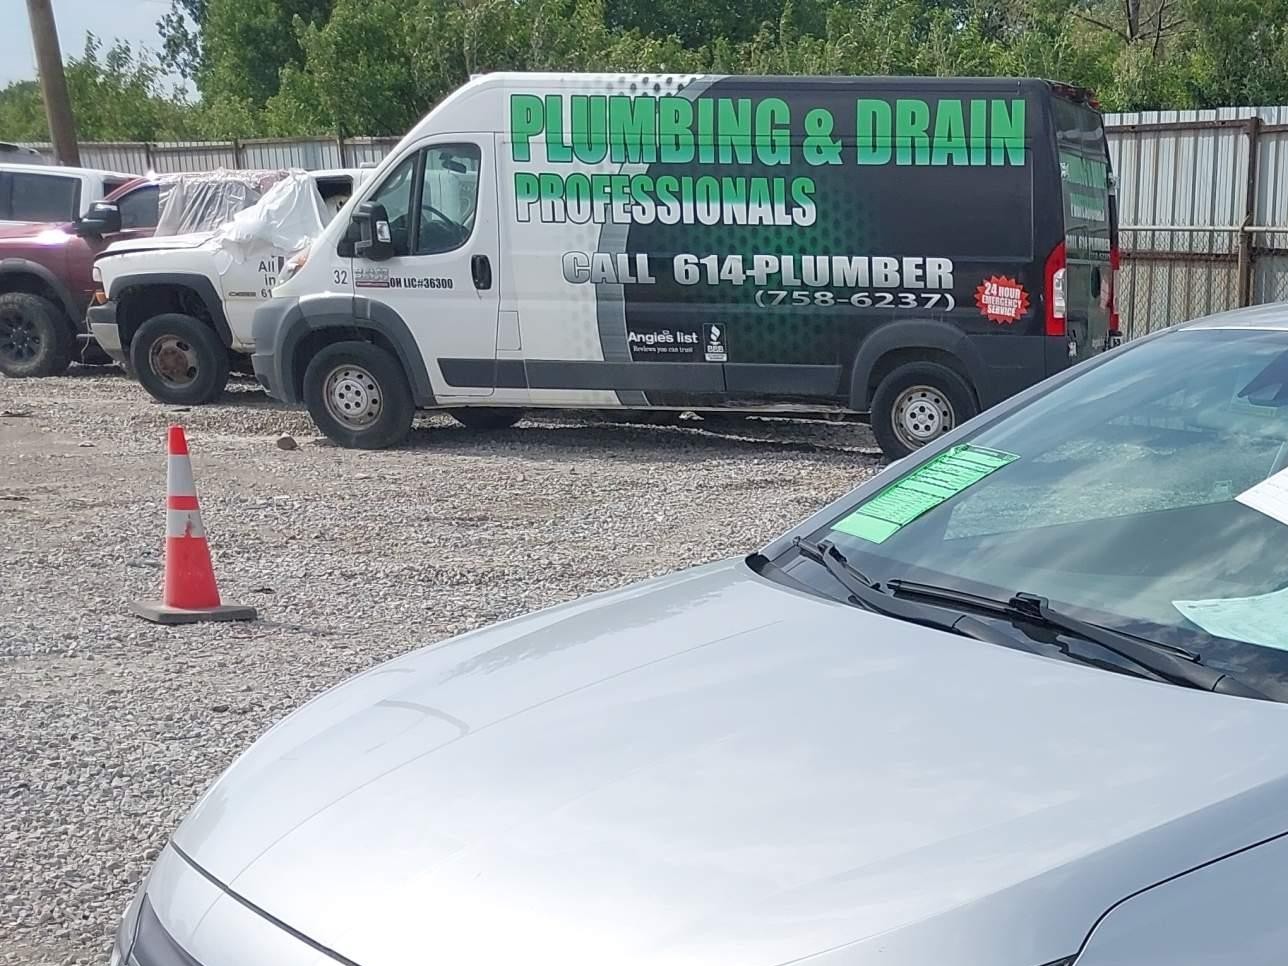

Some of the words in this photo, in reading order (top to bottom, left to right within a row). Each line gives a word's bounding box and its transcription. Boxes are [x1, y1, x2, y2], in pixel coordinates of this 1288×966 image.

[510, 94, 791, 166] PLUMBING
[802, 108, 844, 166] &
[856, 98, 1026, 166] DRAIN
[514, 172, 817, 227] PROFESSIONALS
[333, 270, 348, 285] 32
[562, 251, 656, 285] CALL
[673, 253, 954, 289] 614-PLUMBER
[403, 278, 454, 289] LIC#36300
[984, 282, 998, 296] 24
[998, 286, 1021, 299] HOUR
[755, 289, 956, 312] (758-6237)
[981, 294, 1022, 308] EMERGENCY
[986, 304, 1016, 317] SERVICE
[676, 331, 699, 343] list
